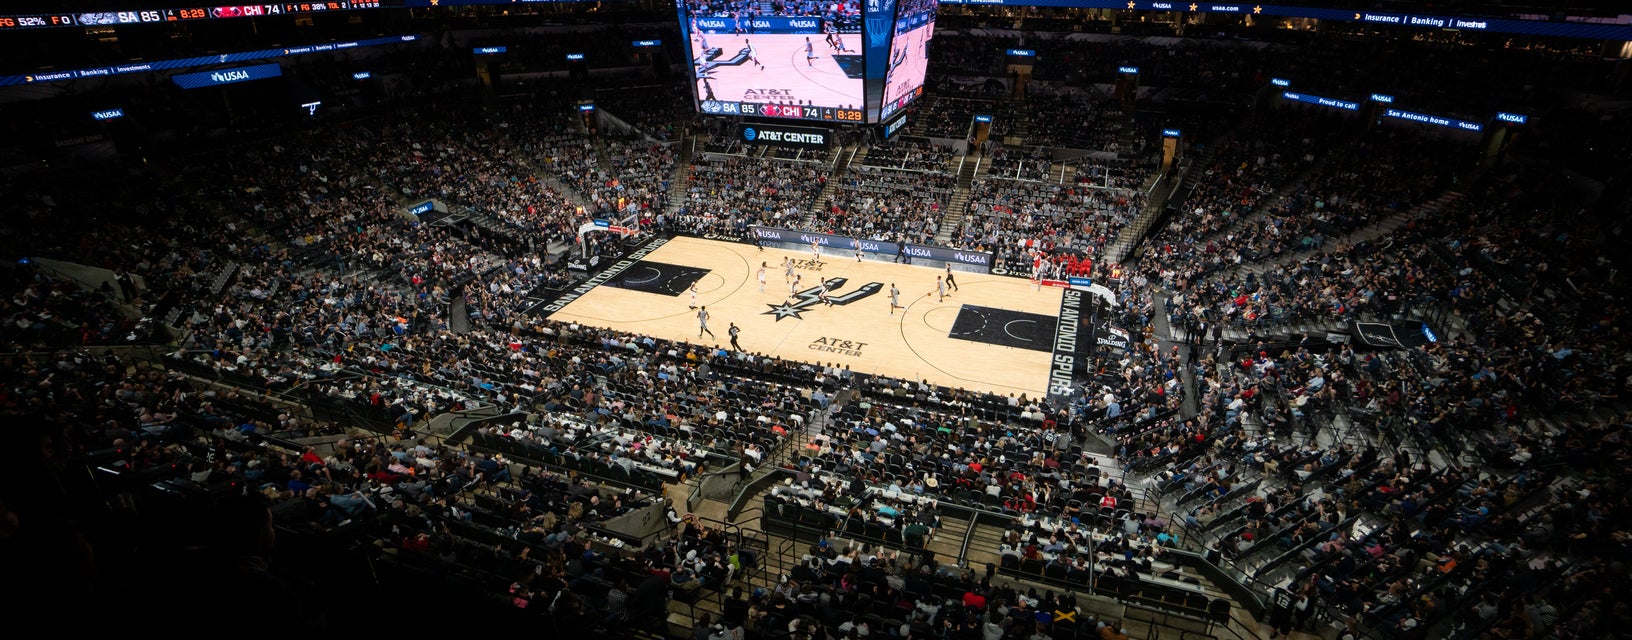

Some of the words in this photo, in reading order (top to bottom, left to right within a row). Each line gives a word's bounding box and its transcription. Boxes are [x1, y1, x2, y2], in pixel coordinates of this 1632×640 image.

[0, 18, 15, 27] FG
[17, 17, 46, 26] 52%
[51, 16, 60, 25] F
[61, 16, 70, 24] 0
[117, 12, 139, 22] SA
[140, 11, 160, 22] 85
[180, 8, 205, 18] 8:29
[244, 5, 263, 16] CHI
[265, 4, 280, 15] 74
[1365, 13, 1399, 23] Insurance
[1411, 16, 1443, 27] Banking
[706, 20, 726, 28] USAA
[752, 20, 770, 28] USAA
[795, 20, 816, 28] USAA
[35, 72, 70, 80] Insurance
[81, 68, 108, 76] Banking
[117, 64, 151, 72] Investments
[224, 70, 249, 81] USAA
[1319, 98, 1336, 106] Proud
[1336, 100, 1344, 108] to
[103, 110, 122, 118] USAA
[723, 104, 737, 112] SA
[741, 104, 754, 113] 85
[783, 108, 800, 116] CHI
[804, 108, 818, 117] 74
[837, 110, 862, 121] 8:29
[1388, 110, 1401, 118] San
[1401, 112, 1429, 122] Antonio
[1429, 116, 1449, 126] home
[1507, 114, 1524, 123] USAA
[758, 131, 783, 140] AT&T
[784, 132, 824, 144] CENTER
[762, 231, 780, 239] USAA
[860, 242, 879, 251] USAA
[911, 248, 931, 257] USAA
[964, 254, 985, 264] USAA
[543, 292, 578, 312] SAN
[574, 260, 633, 294] ANTONIO
[628, 238, 668, 260] SPURS
[1063, 290, 1081, 307] SAN
[1056, 308, 1079, 352] ANTONIO
[813, 336, 868, 351] AT&T
[1096, 337, 1126, 349] SPALDING
[807, 343, 863, 357] CENTER
[1050, 354, 1074, 397] SPURS
